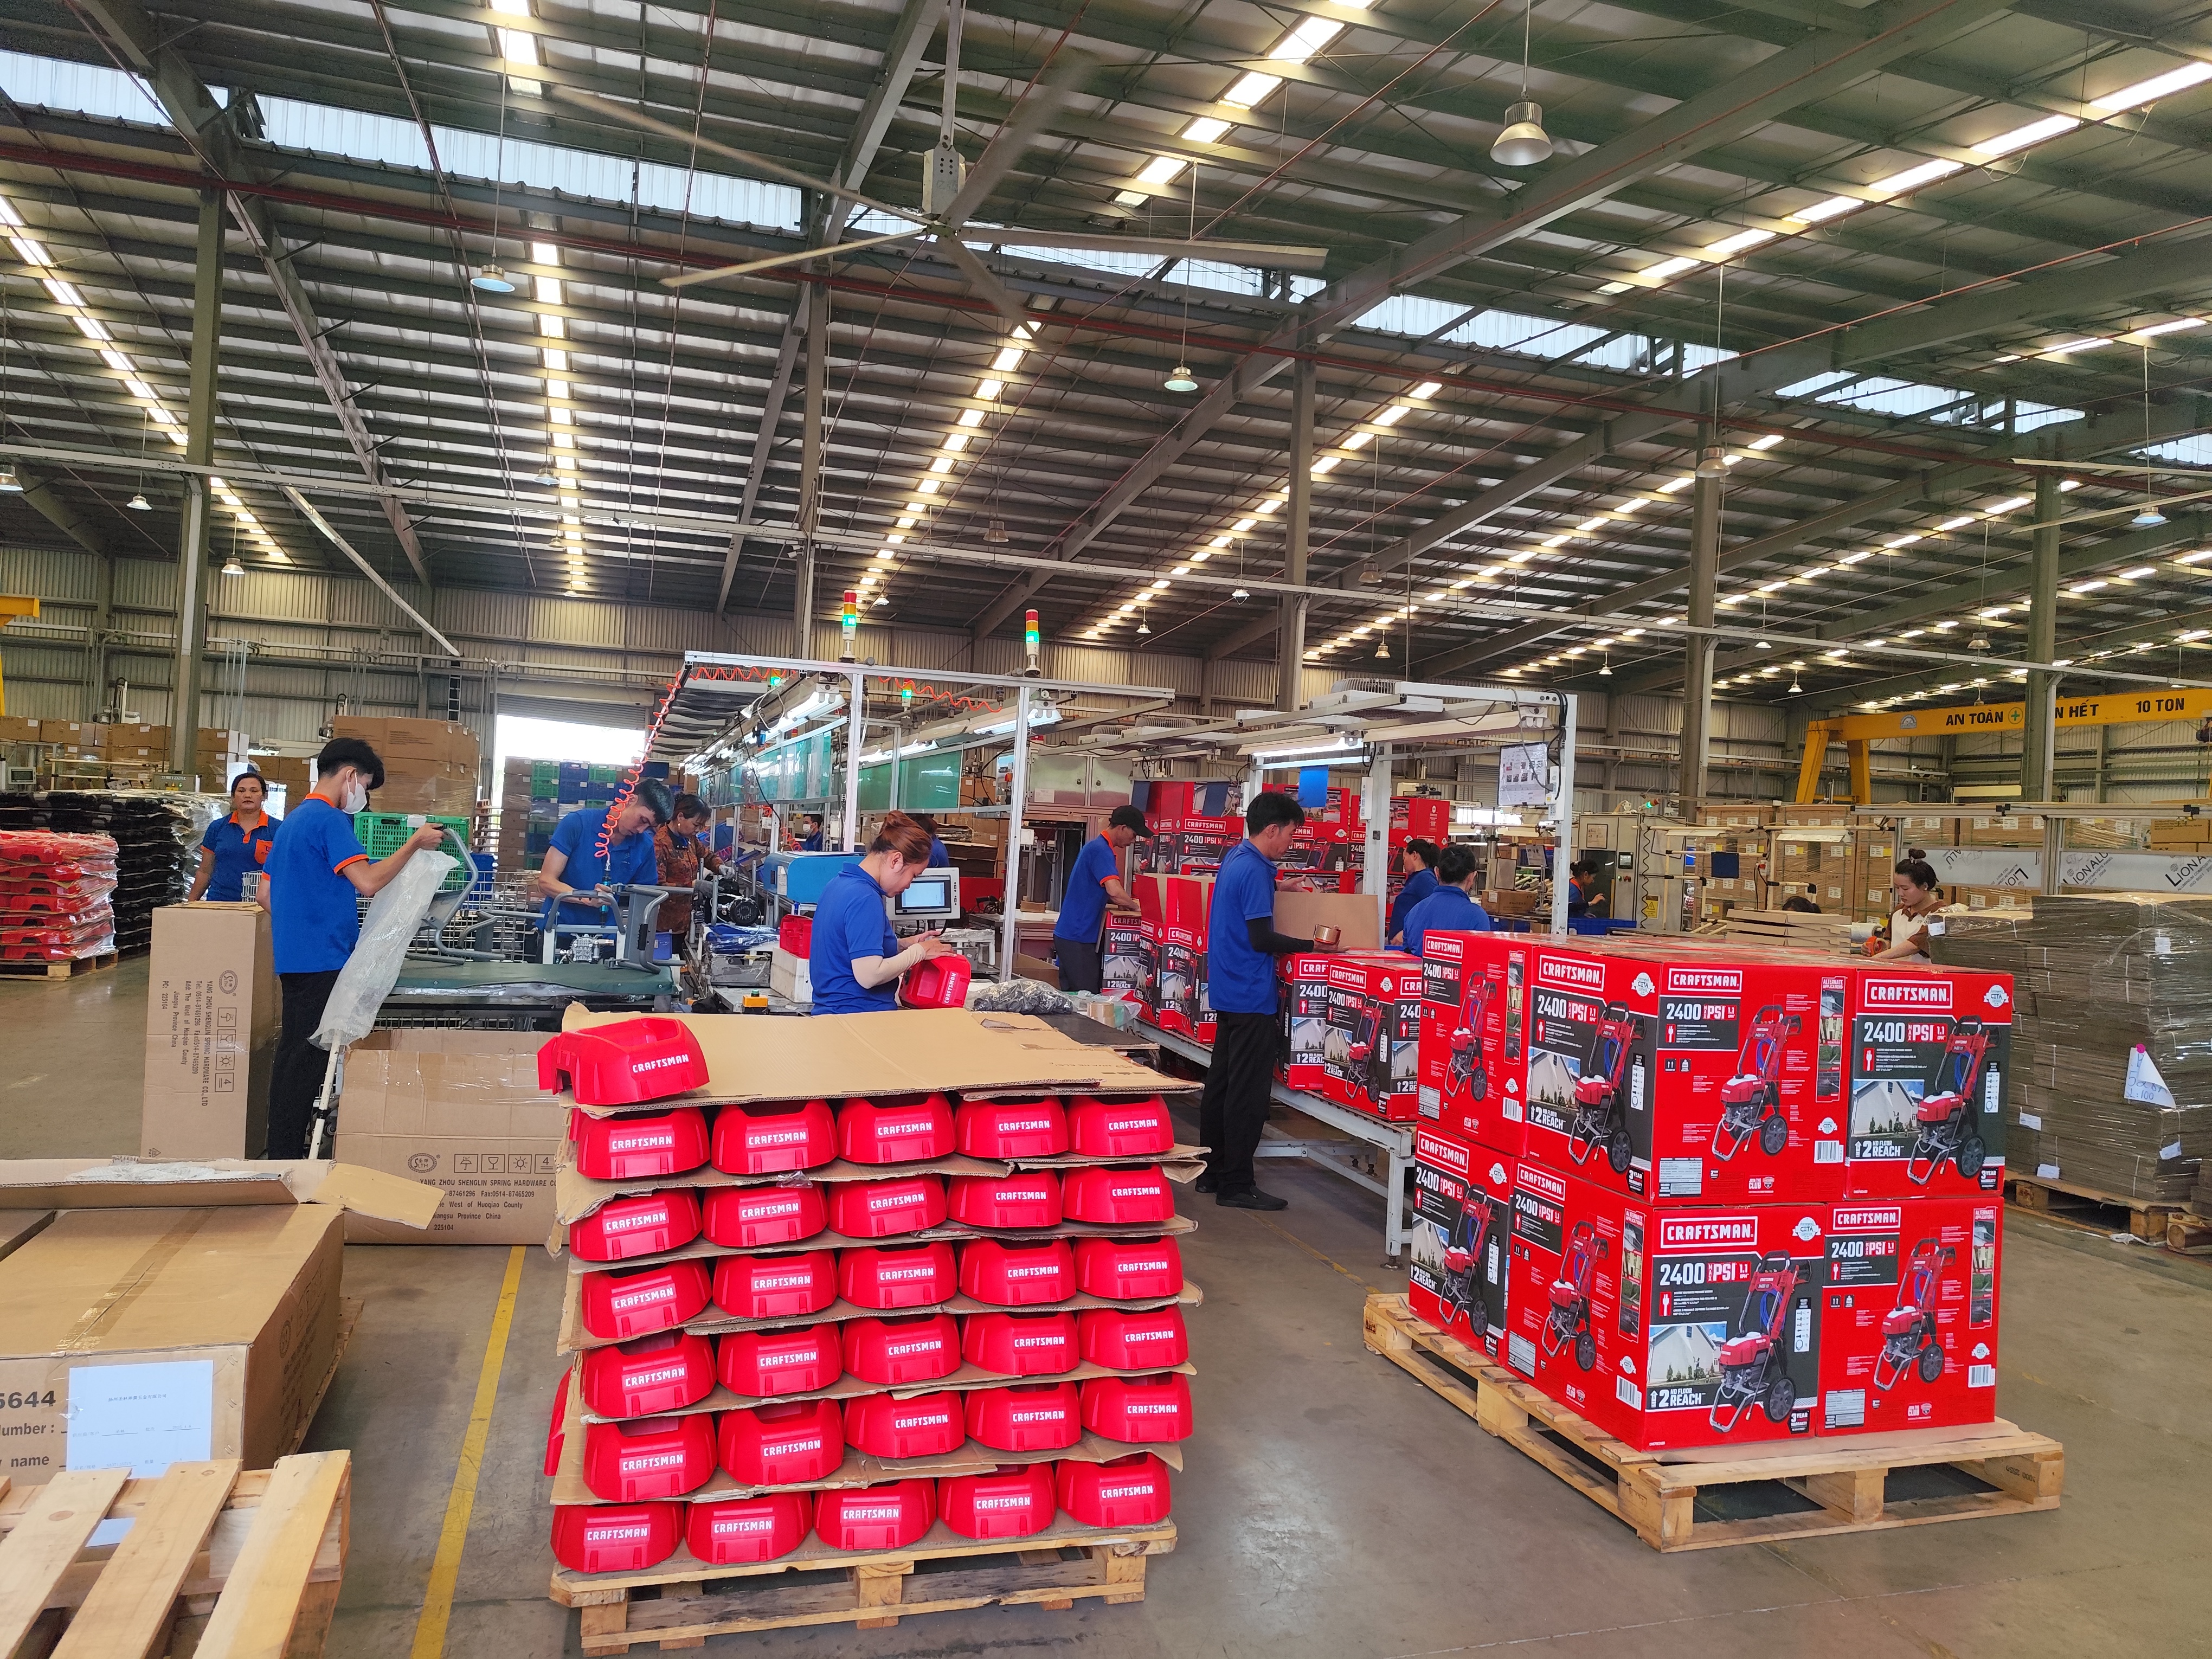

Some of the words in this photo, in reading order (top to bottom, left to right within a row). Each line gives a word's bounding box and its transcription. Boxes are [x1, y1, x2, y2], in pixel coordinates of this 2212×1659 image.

[2069, 699, 2099, 718] HẾT
[2136, 700, 2151, 713] 10
[2156, 698, 2184, 712] TON
[1946, 714, 1964, 725] AN
[1969, 710, 2003, 724] TOÀN
[1185, 835, 1203, 844] 2400
[1110, 932, 1131, 941] 2400
[1427, 941, 1460, 953] CRAFTSMAN
[1332, 970, 1364, 984] CRAFTSMAN
[1424, 963, 1441, 978] 2400
[1444, 967, 1454, 980] PSI
[1543, 962, 1601, 983] CRAFTSMAN
[1674, 974, 1737, 987] CRAFTSMAN
[944, 972, 956, 1004] CRAFTSMAN
[1871, 987, 1946, 1001] CRAFTSMAN
[172, 991, 180, 1008] Jiangsu
[1329, 991, 1345, 1002] 2400
[1538, 995, 1566, 1018] 2400
[1572, 1003, 1588, 1021] PSI
[1667, 1003, 1701, 1020] 2400
[1707, 1005, 1725, 1019] PSI
[1864, 1022, 1905, 1042] 2400
[1913, 1025, 1933, 1041] PSI
[181, 1049, 189, 1065] County
[633, 1054, 689, 1073] CRAFTSMAN
[1302, 1053, 1308, 1063] 2
[1327, 1064, 1331, 1073] 2
[1331, 1068, 1343, 1077] REACH
[1402, 1081, 1409, 1092] 2
[1535, 1107, 1542, 1123] 2
[1543, 1114, 1563, 1130] REACH
[878, 1122, 931, 1135] CRAFTSMAN
[999, 1121, 1050, 1131] CRAFTSMAN
[1109, 1119, 1157, 1130] CRAFTSMAN
[612, 1136, 672, 1149] CRAFTSMAN
[749, 1131, 806, 1145] CRAFTSMAN
[1421, 1138, 1466, 1166] CRAFTSMAN
[1862, 1141, 1872, 1157] 2
[1873, 1146, 1900, 1157] REACH
[543, 1157, 549, 1165] 4
[1416, 1167, 1439, 1191] 2400
[1443, 1179, 1456, 1198] PSI
[1520, 1169, 1562, 1194] CRAFTSMAN
[996, 1192, 1046, 1200] CRAFTSMAN
[1112, 1187, 1160, 1197] CRAFTSMAN
[871, 1193, 924, 1209] CRAFTSMAN
[1515, 1194, 1538, 1216] 2400
[1541, 1206, 1553, 1221] PSI
[742, 1203, 799, 1218] CRAFTSMAN
[1626, 1211, 1643, 1221] ALTERNATE
[606, 1212, 666, 1231] CRAFTSMAN
[1838, 1212, 1898, 1224] CRAFTSMAN
[1667, 1224, 1752, 1240] CRAFTSMAN
[1831, 1242, 1863, 1258] 2400
[1869, 1242, 1886, 1255] PSI
[880, 1268, 934, 1280] CRAFTSMAN
[1008, 1266, 1058, 1277] CRAFTSMAN
[1118, 1262, 1167, 1272] CRAFTSMAN
[1414, 1266, 1419, 1281] 2
[1660, 1263, 1705, 1285] 2400
[1713, 1263, 1737, 1281] PSI
[1739, 1264, 1748, 1273] 1.1
[754, 1276, 810, 1289] CRAFTSMAN
[1419, 1274, 1435, 1290] REACH
[614, 1288, 673, 1309] CRAFTSMAN
[1014, 1336, 1064, 1347] CRAFTSMAN
[1126, 1330, 1174, 1342] CRAFTSMAN
[889, 1341, 941, 1355] CRAFTSMAN
[760, 1352, 816, 1367] CRAFTSMAN
[625, 1367, 685, 1387] CRAFTSMAN
[1659, 1390, 1669, 1407] 2
[1670, 1393, 1701, 1406] REACH
[1127, 1405, 1177, 1413] CRAFTSMAN
[896, 1414, 948, 1428] CRAFTSMAN
[1013, 1411, 1064, 1422] CRAFTSMAN
[1791, 1413, 1797, 1423] 3
[764, 1440, 820, 1456] CRAFTSMAN
[11, 1456, 49, 1467] name
[623, 1455, 683, 1471] CRAFTSMAN
[1102, 1486, 1153, 1498] CRAFTSMAN
[976, 1497, 1030, 1509] CRAFTSMAN
[844, 1509, 899, 1519] CRAFTSMAN
[715, 1520, 771, 1533] CRAFTSMAN
[587, 1528, 647, 1540] CRAFTSMAN
